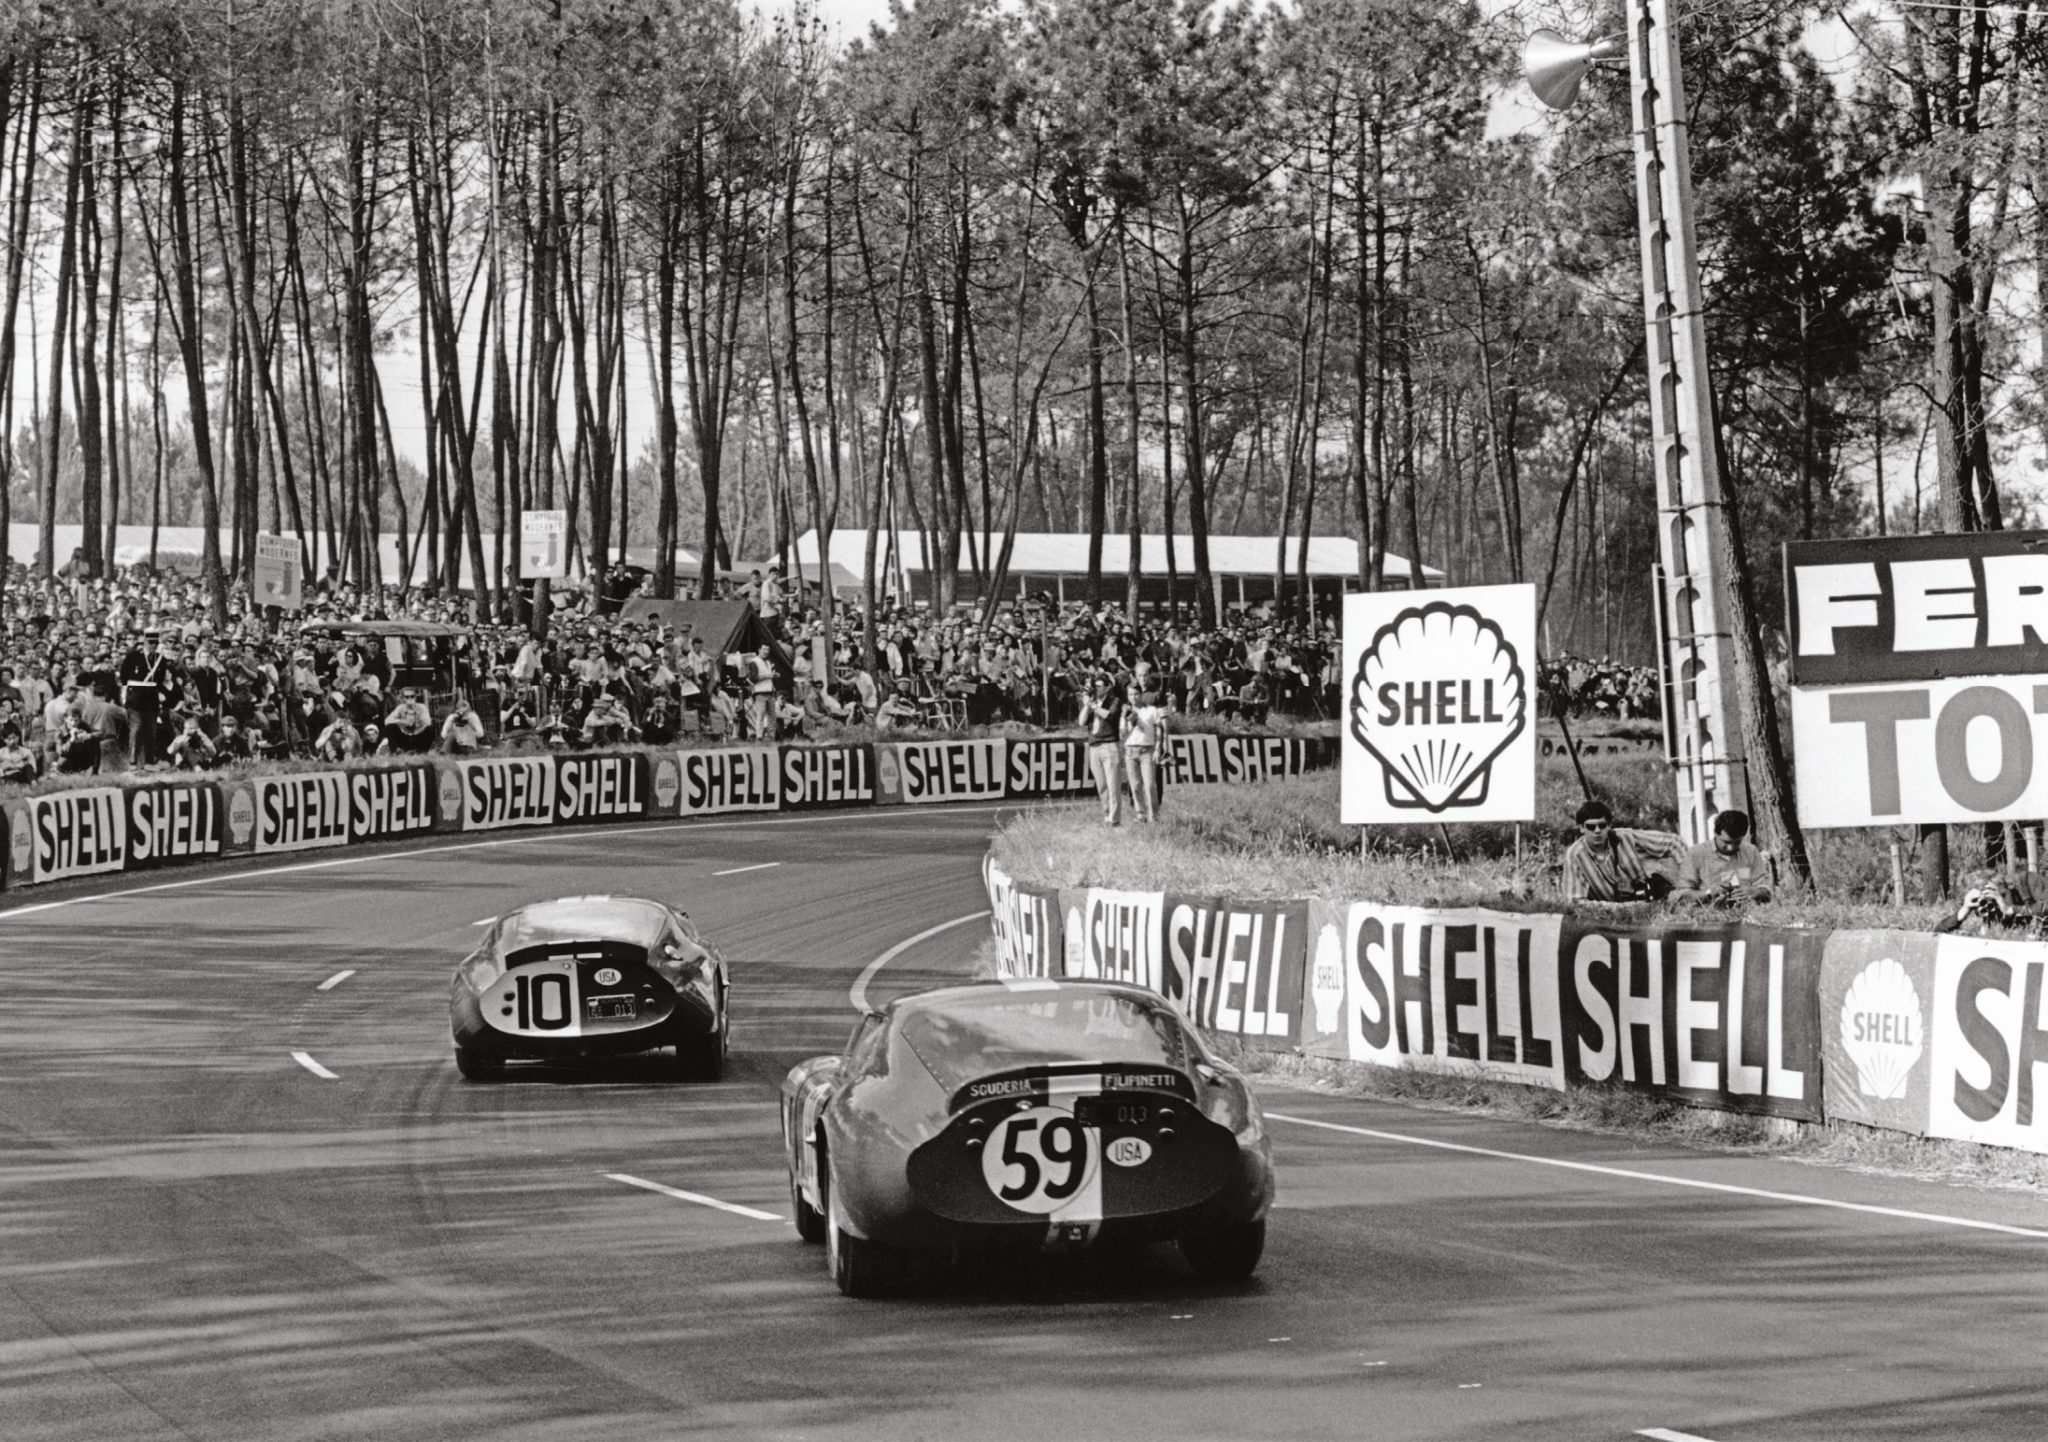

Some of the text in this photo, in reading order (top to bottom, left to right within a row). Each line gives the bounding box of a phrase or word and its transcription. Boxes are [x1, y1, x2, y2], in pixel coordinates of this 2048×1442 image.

[1794, 554, 2048, 656] FER
[1377, 678, 1503, 727] SHELL
[784, 747, 873, 803] SHELL
[905, 745, 1000, 798] SHELL
[1011, 742, 1095, 793] SHELL
[1166, 739, 1219, 785] ELL
[1223, 737, 1305, 785] SHELL
[1828, 684, 2048, 816] TO
[352, 768, 432, 836] SHELL
[468, 762, 551, 824] SHELL
[559, 758, 642, 819] SHELL
[686, 752, 776, 808] SHELL
[37, 793, 122, 874] SHELL
[132, 787, 220, 860] SHELL
[263, 777, 345, 845] SHELL
[598, 971, 617, 983] USA
[1168, 904, 1289, 1037] SHELL
[1317, 965, 1341, 991] SHELL
[1356, 916, 1554, 1068] SHELL
[515, 973, 572, 1031] 10
[614, 1003, 634, 1017] 013
[1574, 933, 1805, 1100] SHELL
[1853, 1012, 1914, 1047] SHELL
[969, 1073, 1176, 1097] SCUDERIA FILIPINETTI
[1118, 1105, 1148, 1123] 013
[999, 1116, 1088, 1202] 59
[1114, 1141, 1143, 1162] USA
